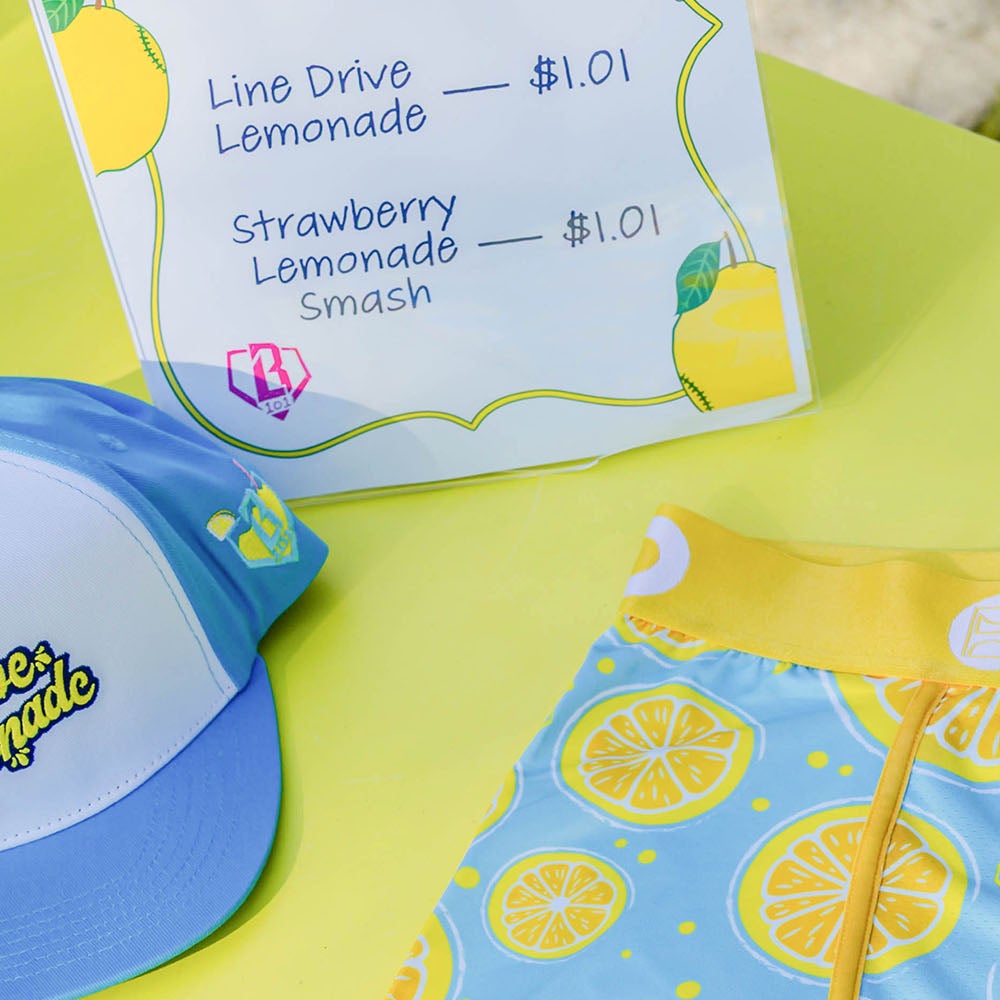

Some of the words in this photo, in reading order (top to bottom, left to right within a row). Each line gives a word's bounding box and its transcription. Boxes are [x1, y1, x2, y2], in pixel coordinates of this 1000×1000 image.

[208, 75, 293, 110] Line
[306, 59, 411, 98] Drive
[530, 48, 629, 95] $1.01
[216, 97, 427, 154] Lemonade
[232, 195, 456, 244] Strawberry
[563, 204, 660, 248] $1.01
[253, 230, 459, 285] Lemonade
[300, 277, 431, 320] Smash
[265, 397, 292, 415] 101
